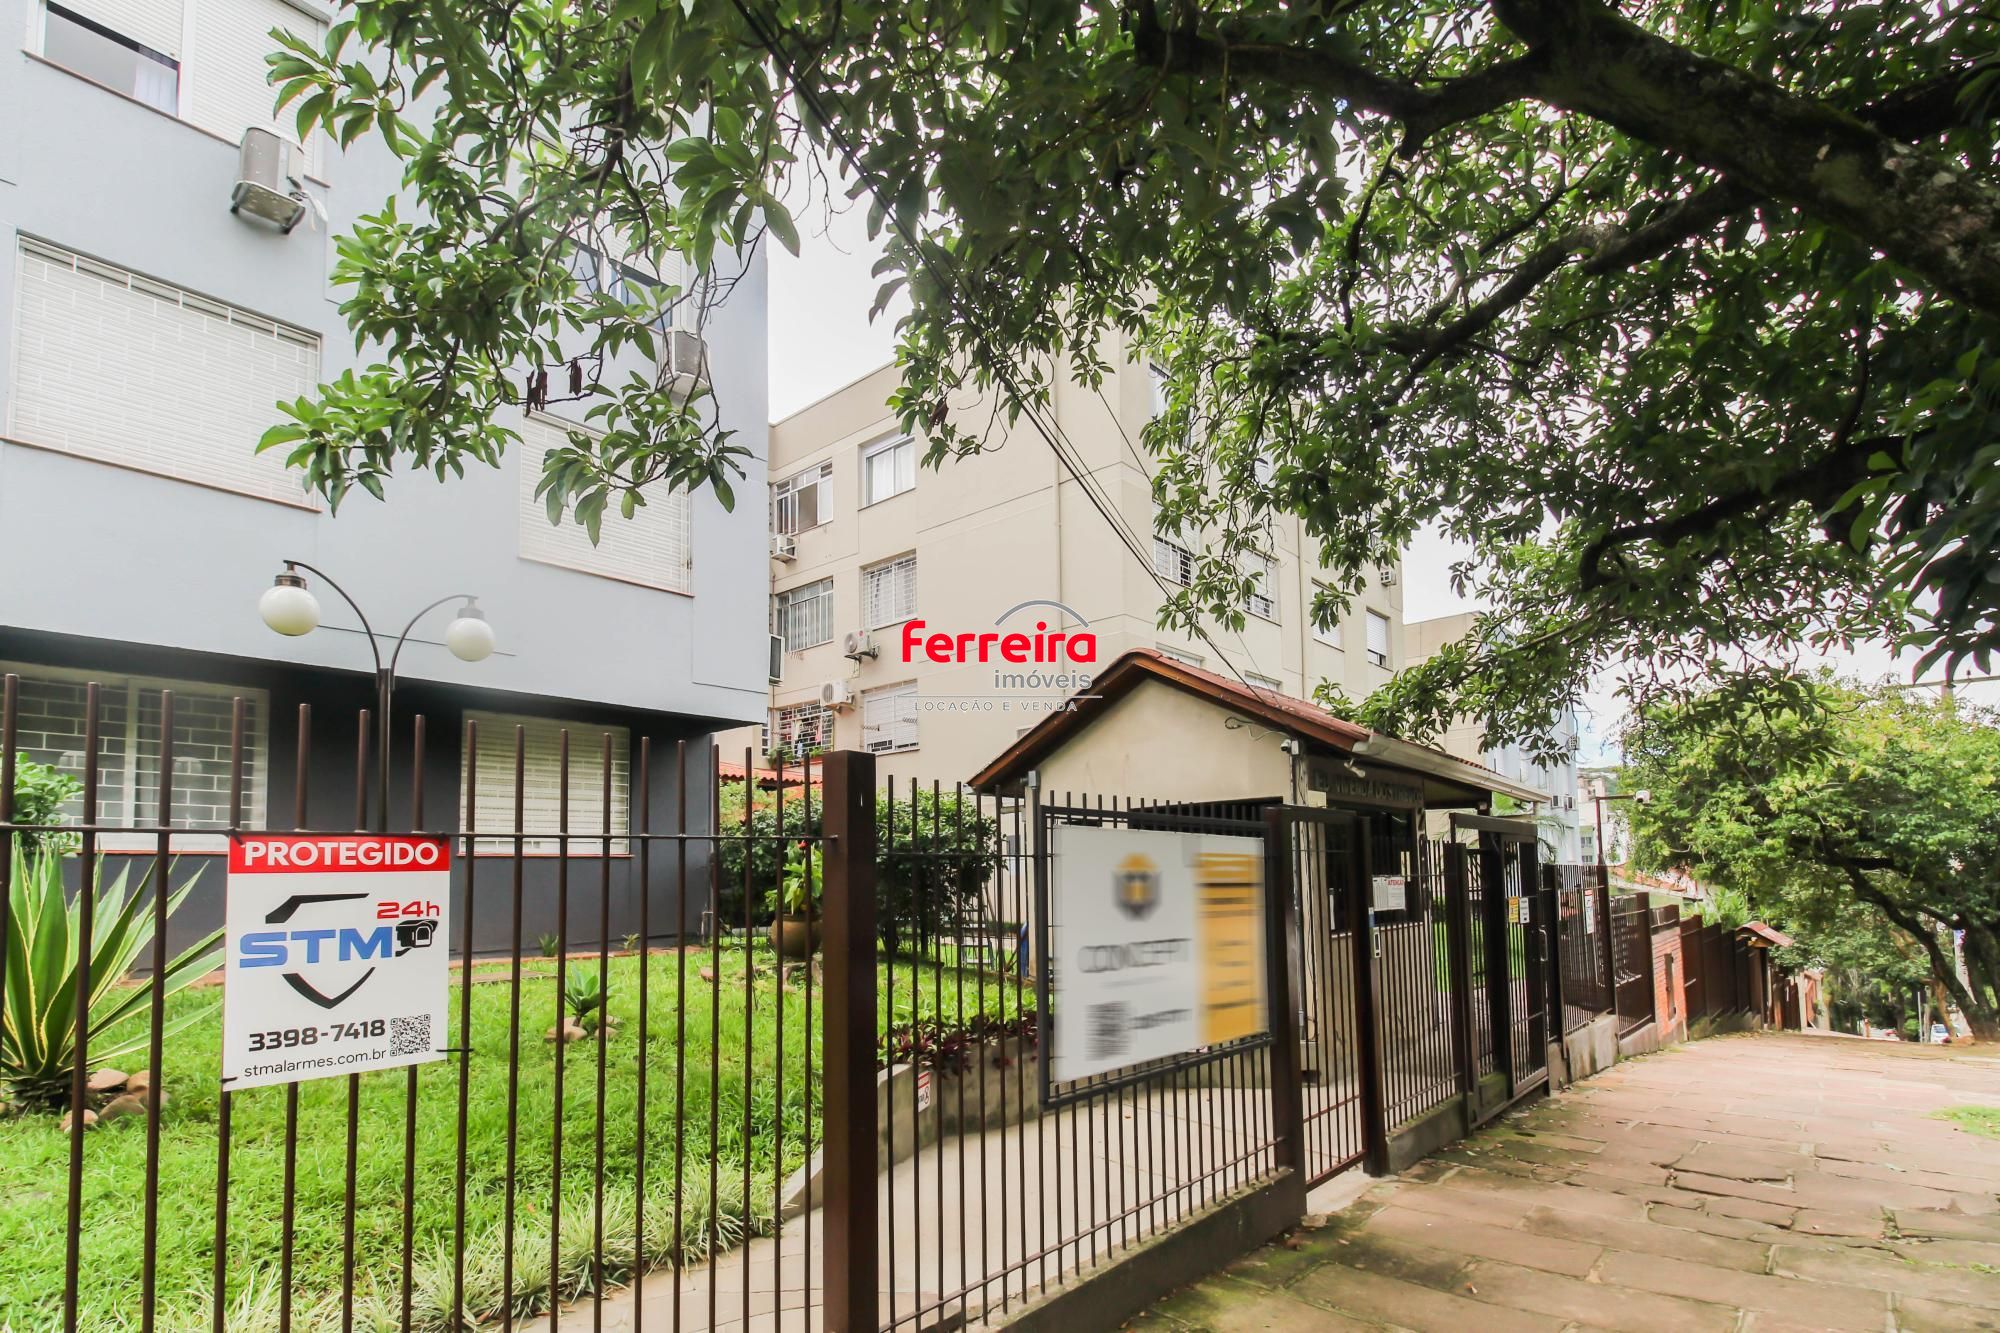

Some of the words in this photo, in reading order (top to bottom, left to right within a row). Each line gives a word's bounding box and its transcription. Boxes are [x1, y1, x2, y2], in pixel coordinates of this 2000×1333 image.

[243, 841, 439, 867] PROTEGIDO
[376, 900, 440, 919] 24h
[239, 926, 393, 969] STM
[248, 1019, 386, 1052] 3398-7418
[244, 1048, 387, 1078] stmalarmes.com.br
